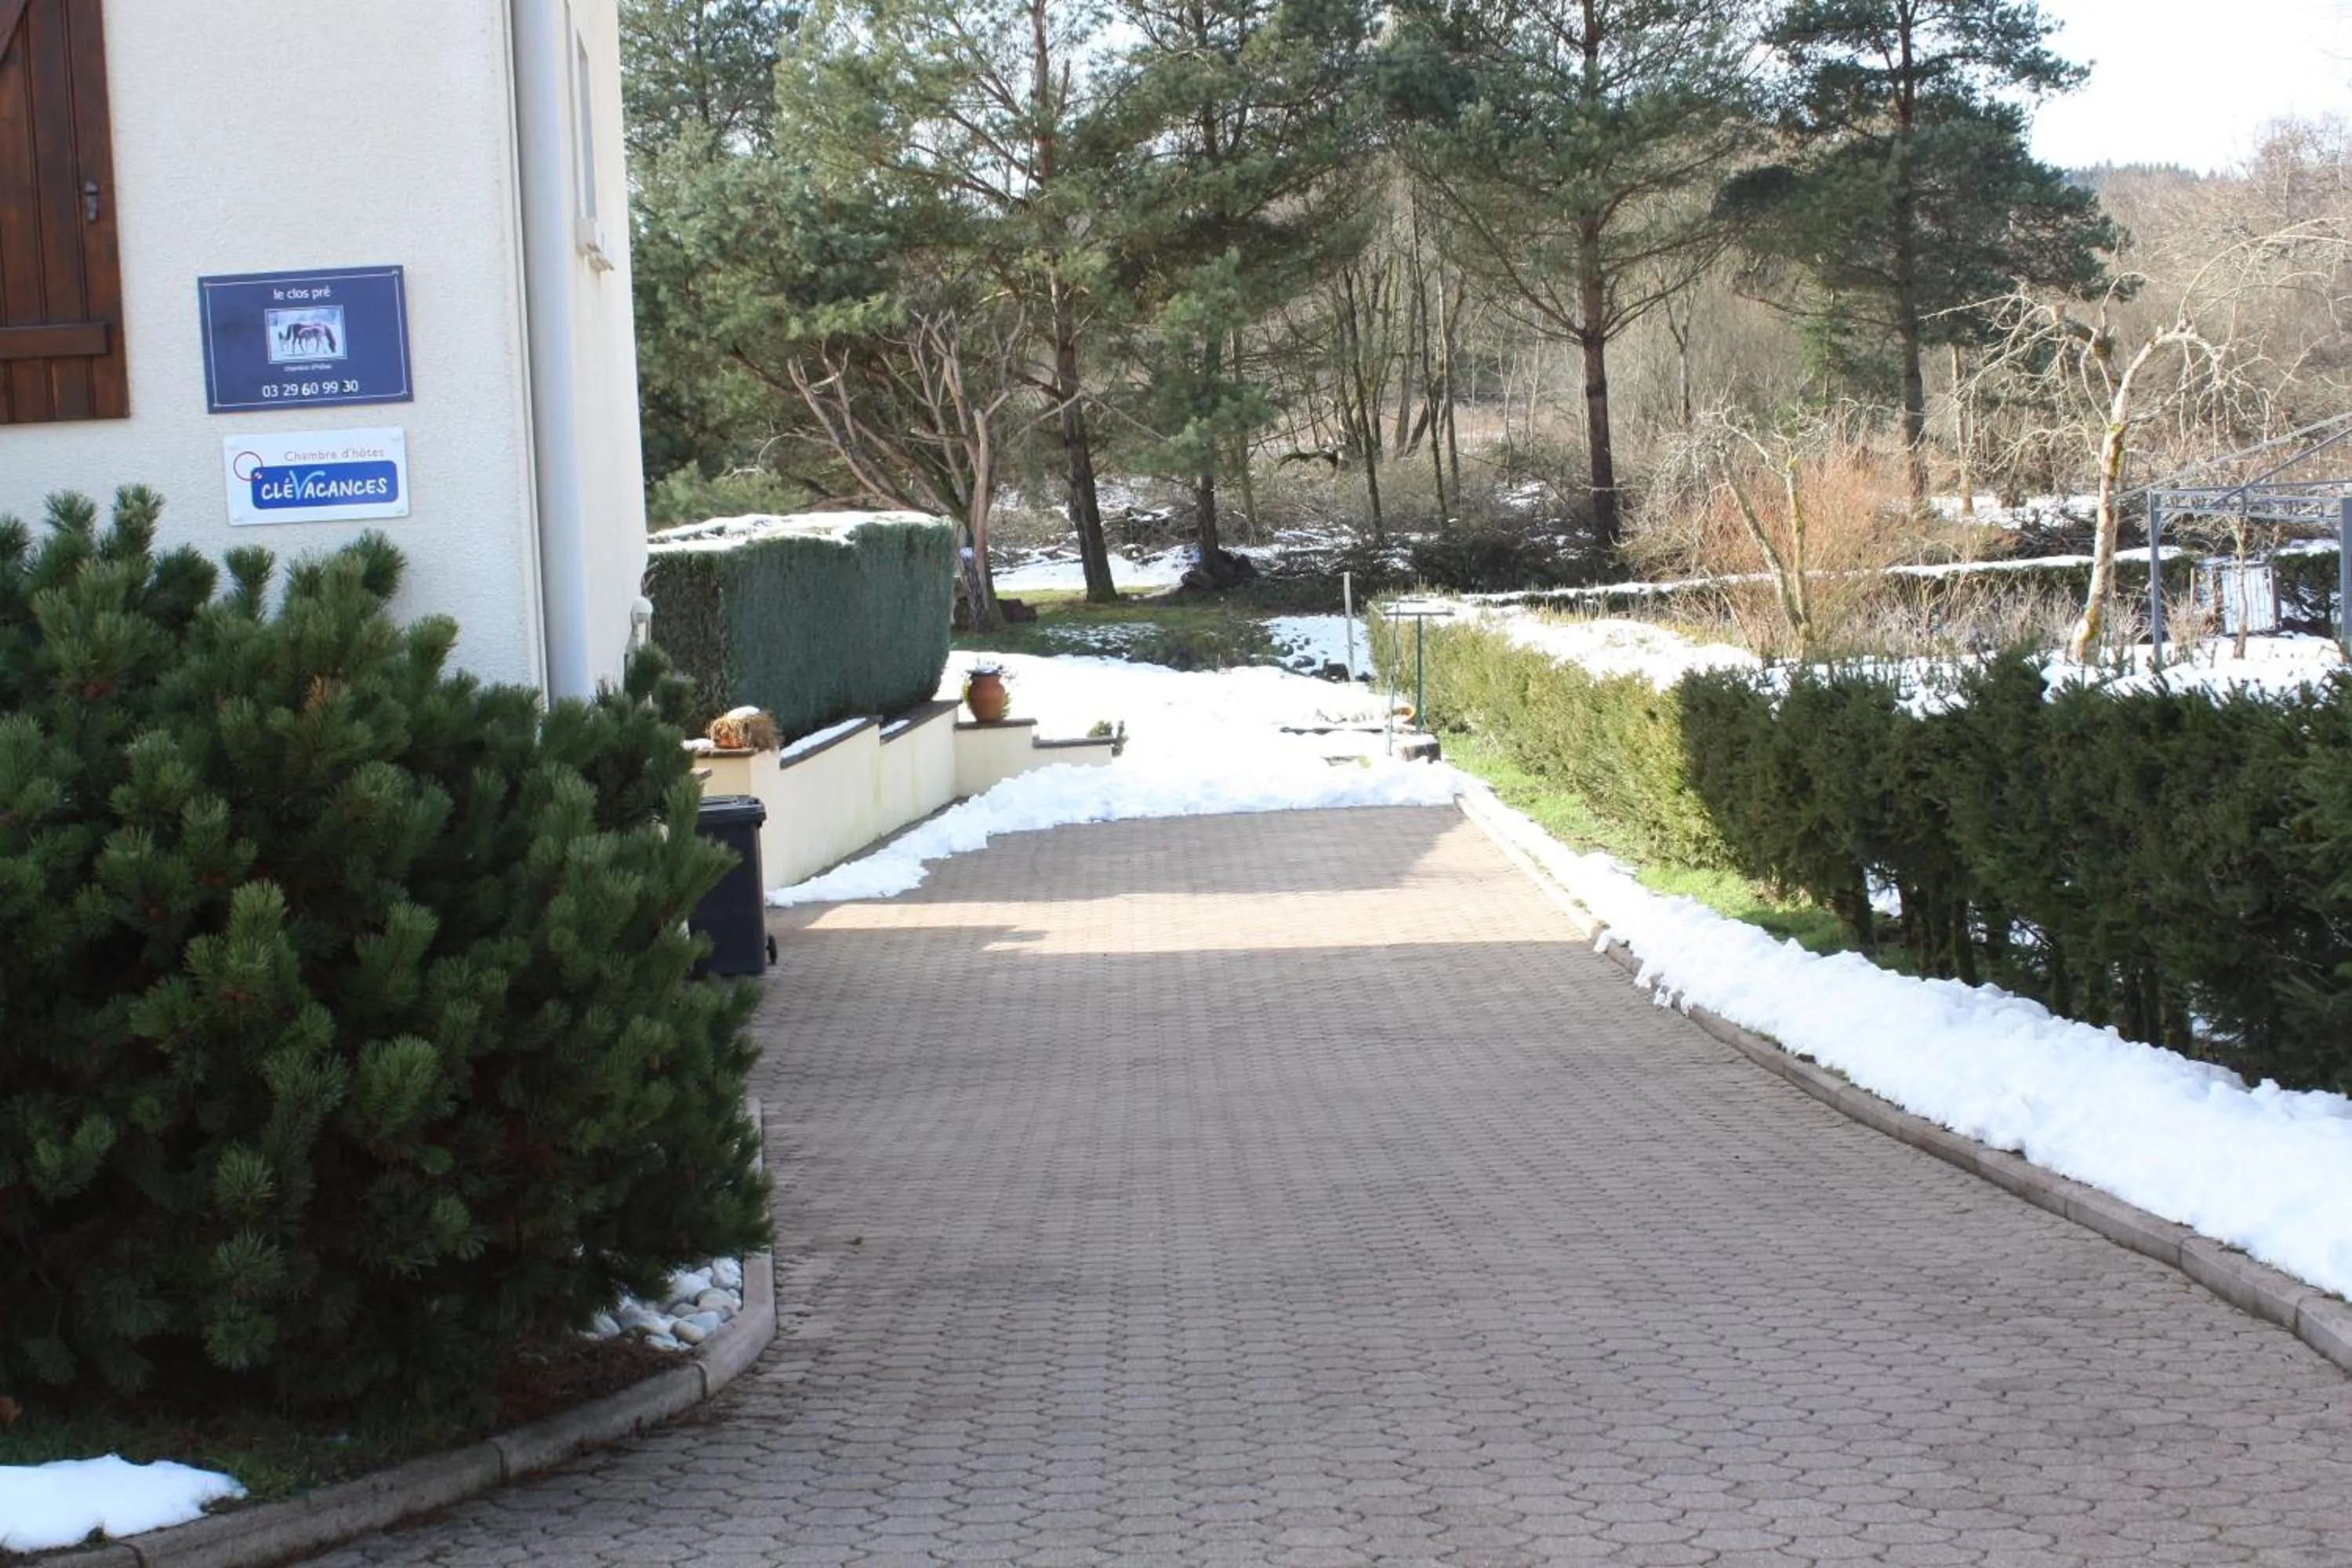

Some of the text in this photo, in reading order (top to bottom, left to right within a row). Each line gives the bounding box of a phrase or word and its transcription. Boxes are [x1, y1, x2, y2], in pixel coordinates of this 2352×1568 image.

[274, 285, 332, 300] le clos pré
[263, 379, 358, 397] 03 29 60 99 30
[284, 450, 338, 463] Chambre
